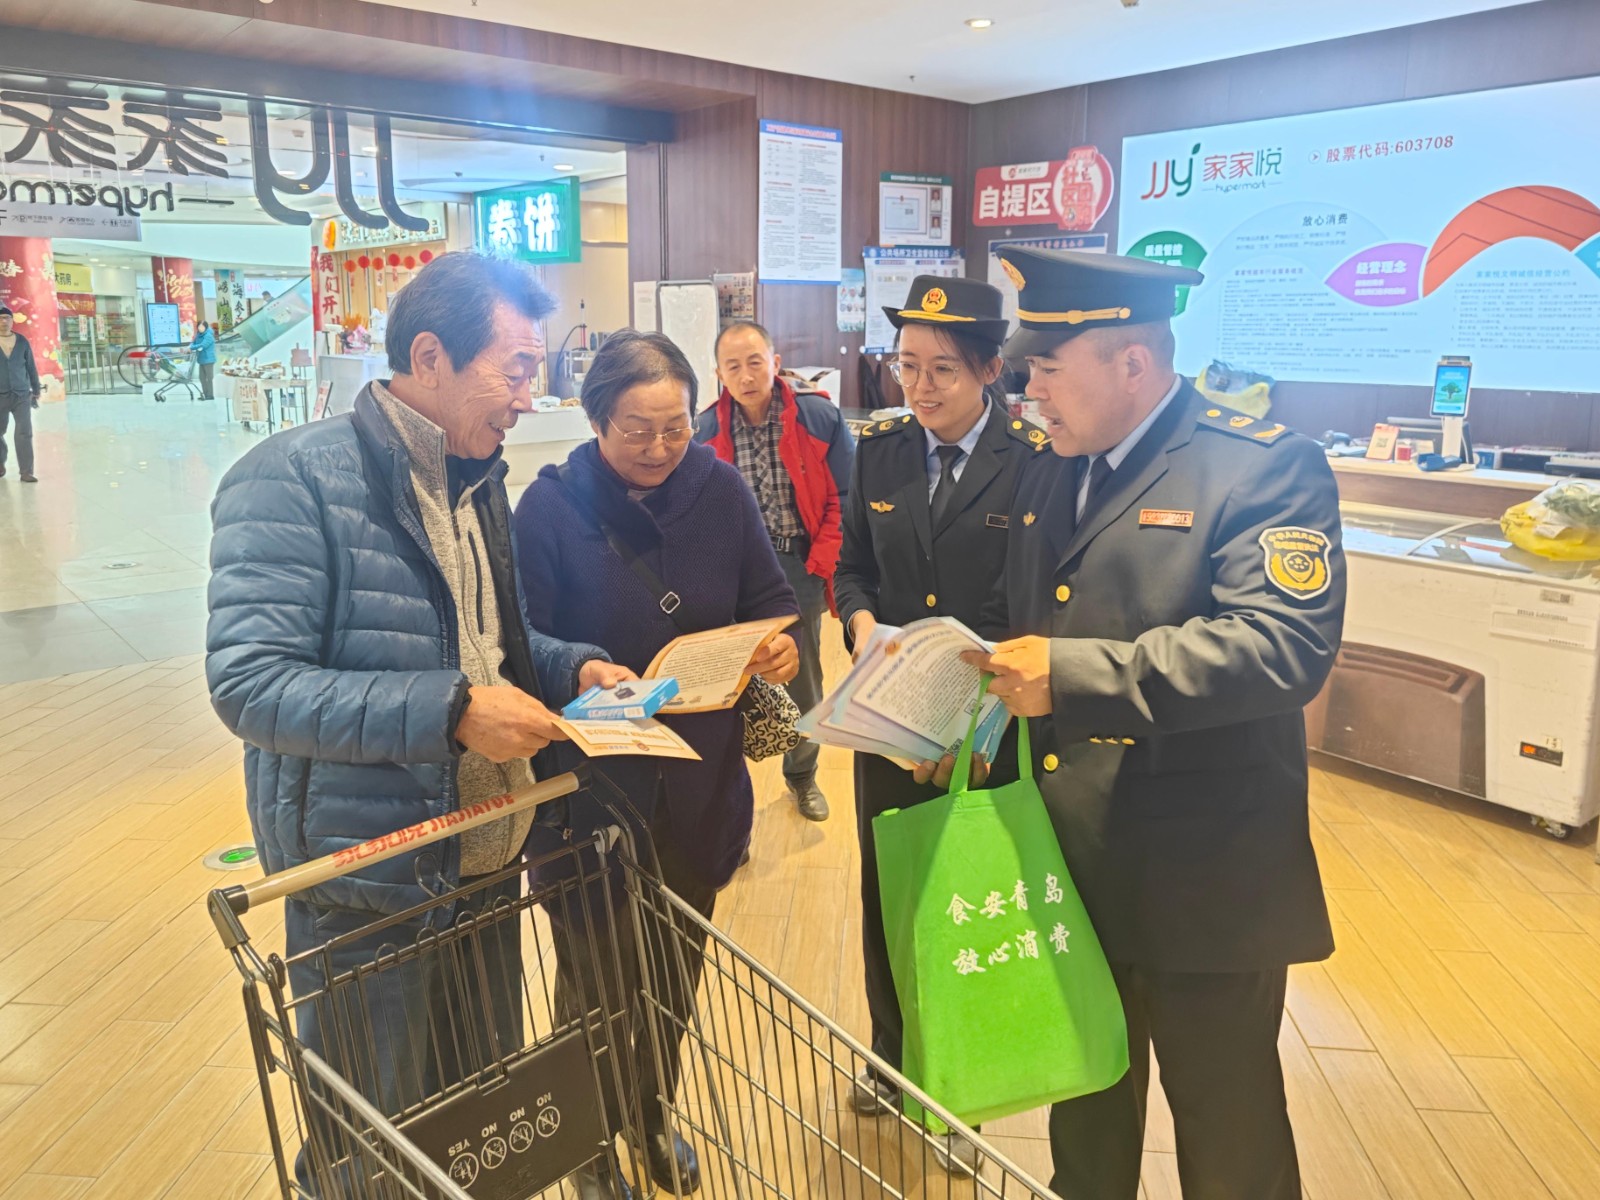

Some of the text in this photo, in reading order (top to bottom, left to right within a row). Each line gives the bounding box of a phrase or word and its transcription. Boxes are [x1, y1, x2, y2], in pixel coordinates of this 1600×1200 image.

[1202, 148, 1283, 182] 家家悦
[1326, 135, 1454, 163] 股票代码:603708
[979, 182, 1052, 219] 自提区
[1215, 180, 1267, 193] hypermart
[1302, 213, 1348, 227] 放心消费
[1356, 260, 1407, 274] 经营理念
[946, 873, 1064, 925] 食安青岛
[952, 922, 1070, 975] 放心消费
[448, 1092, 552, 1157] NO NO NO YES
